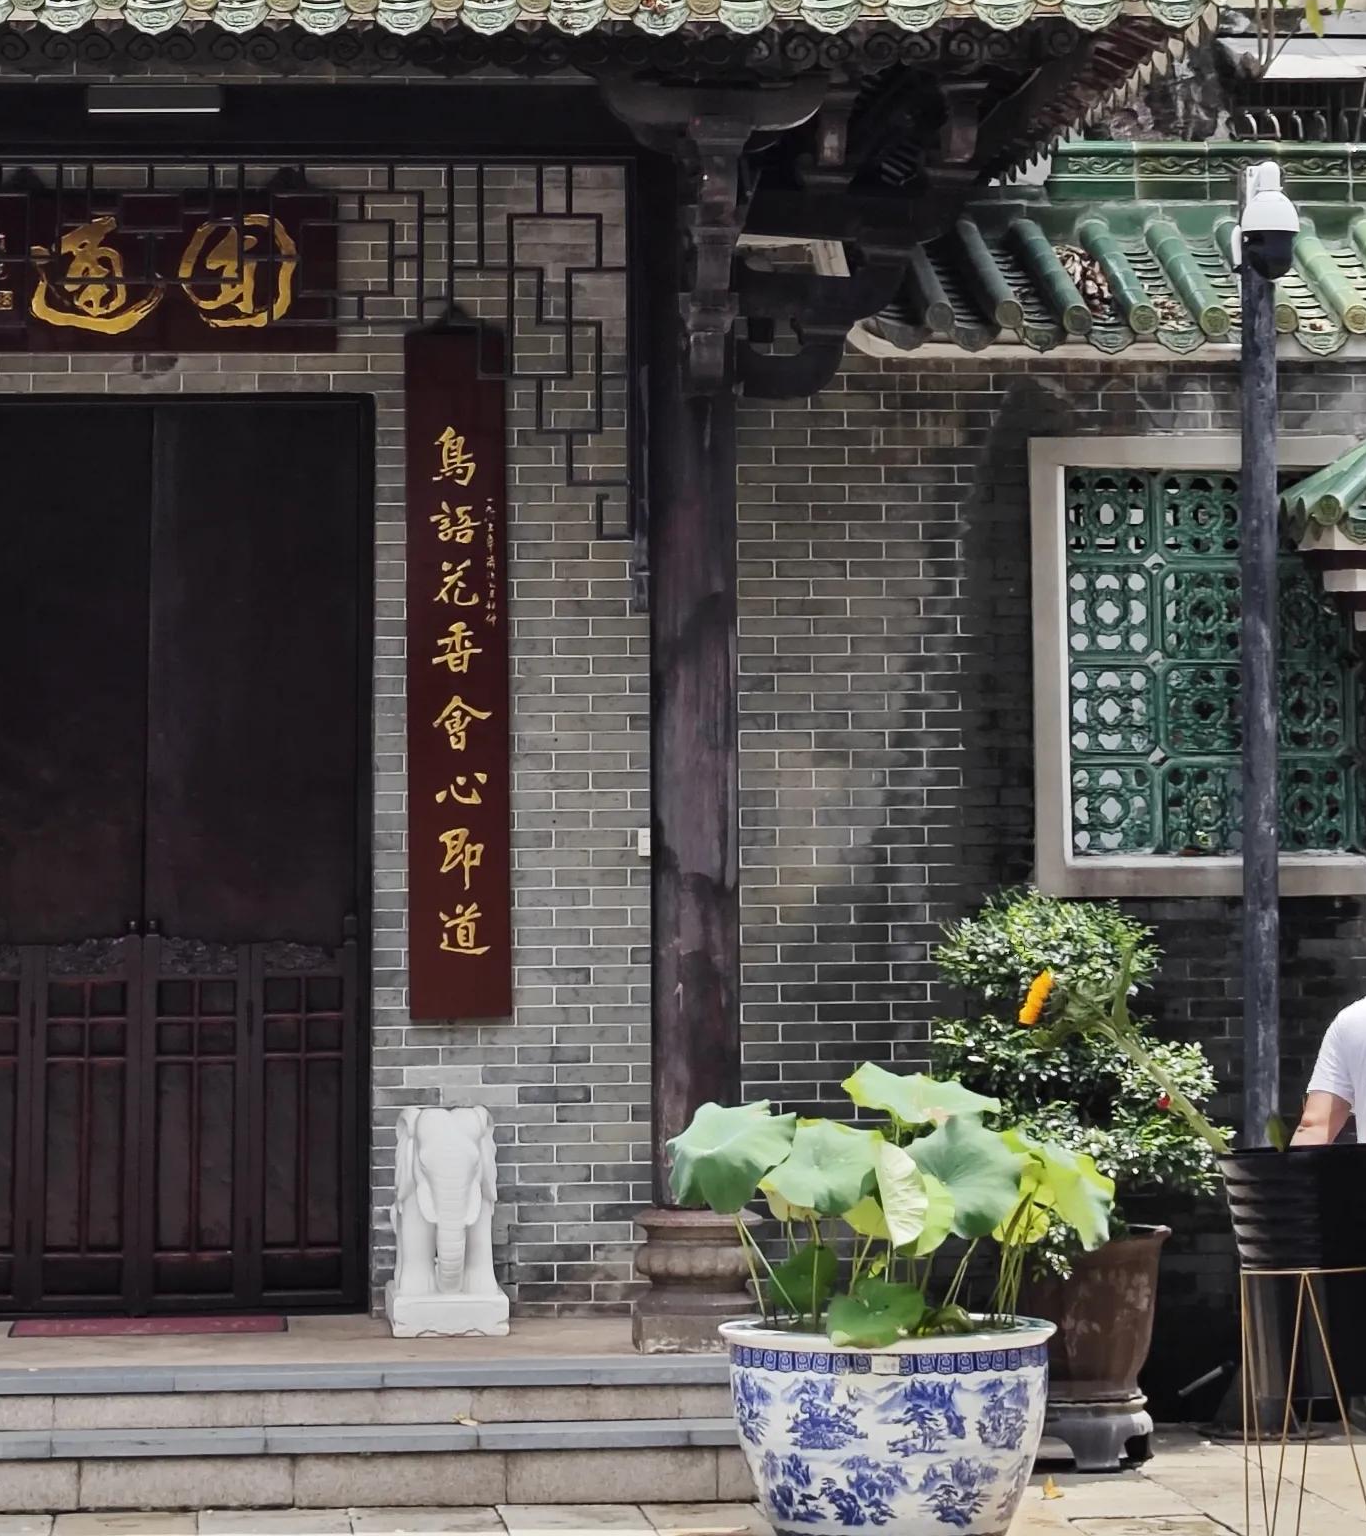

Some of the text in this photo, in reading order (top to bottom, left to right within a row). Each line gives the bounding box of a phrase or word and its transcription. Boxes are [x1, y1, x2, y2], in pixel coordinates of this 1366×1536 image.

[430, 426, 493, 955] 鳥語花香會心即道
